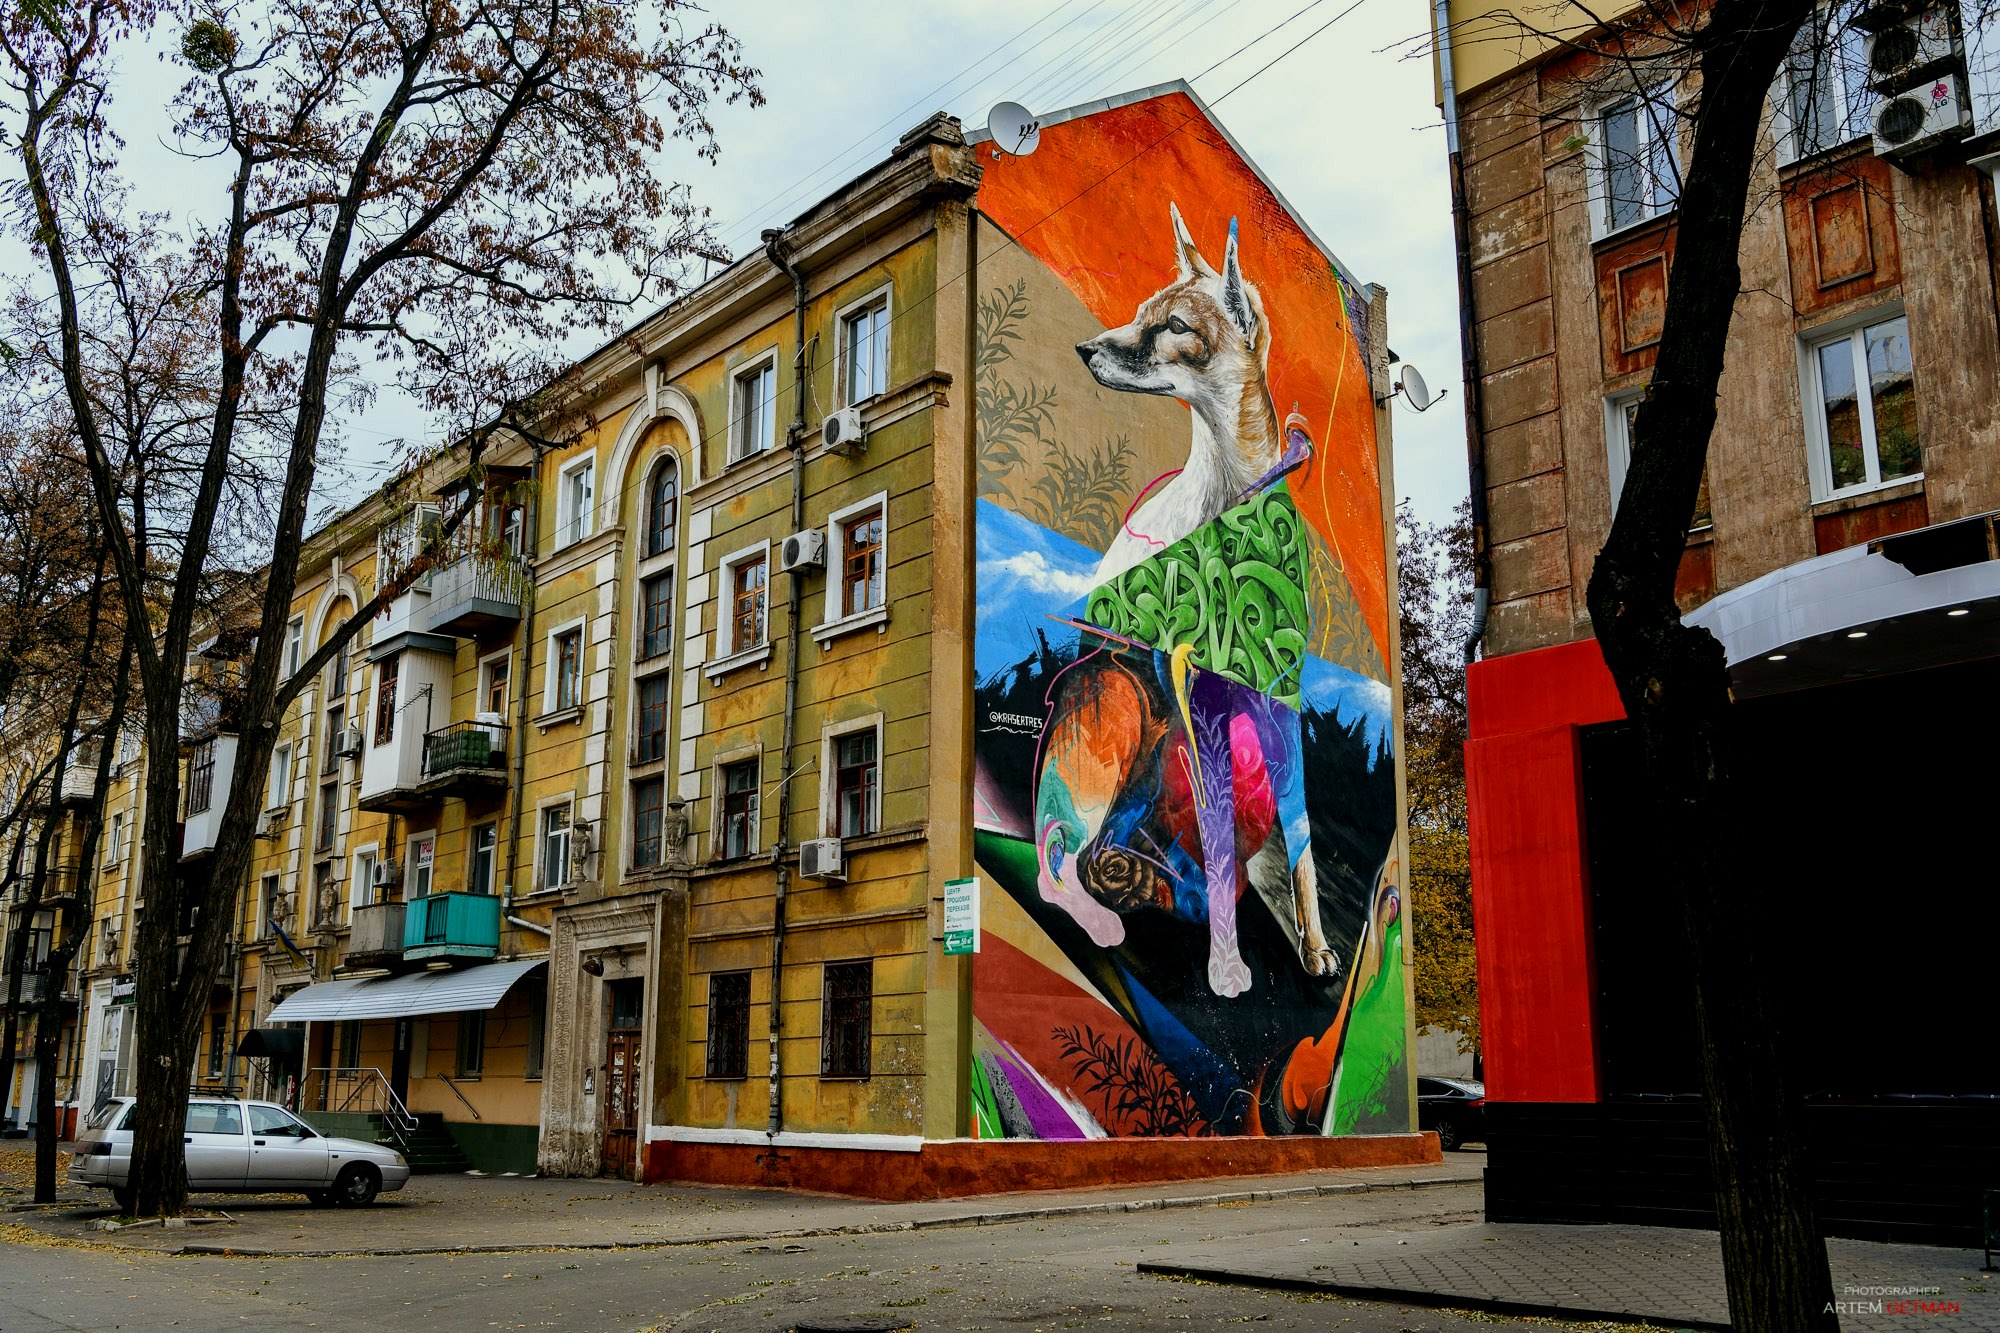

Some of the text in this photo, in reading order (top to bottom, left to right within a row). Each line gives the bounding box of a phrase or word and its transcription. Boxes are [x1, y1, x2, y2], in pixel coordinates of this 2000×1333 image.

[1934, 100, 1948, 109] LG
[946, 887, 961, 895] ЦЕНТР
[946, 895, 971, 904] ГРОШОВИХ
[946, 904, 970, 912] ПЕРЕКАЗІВ
